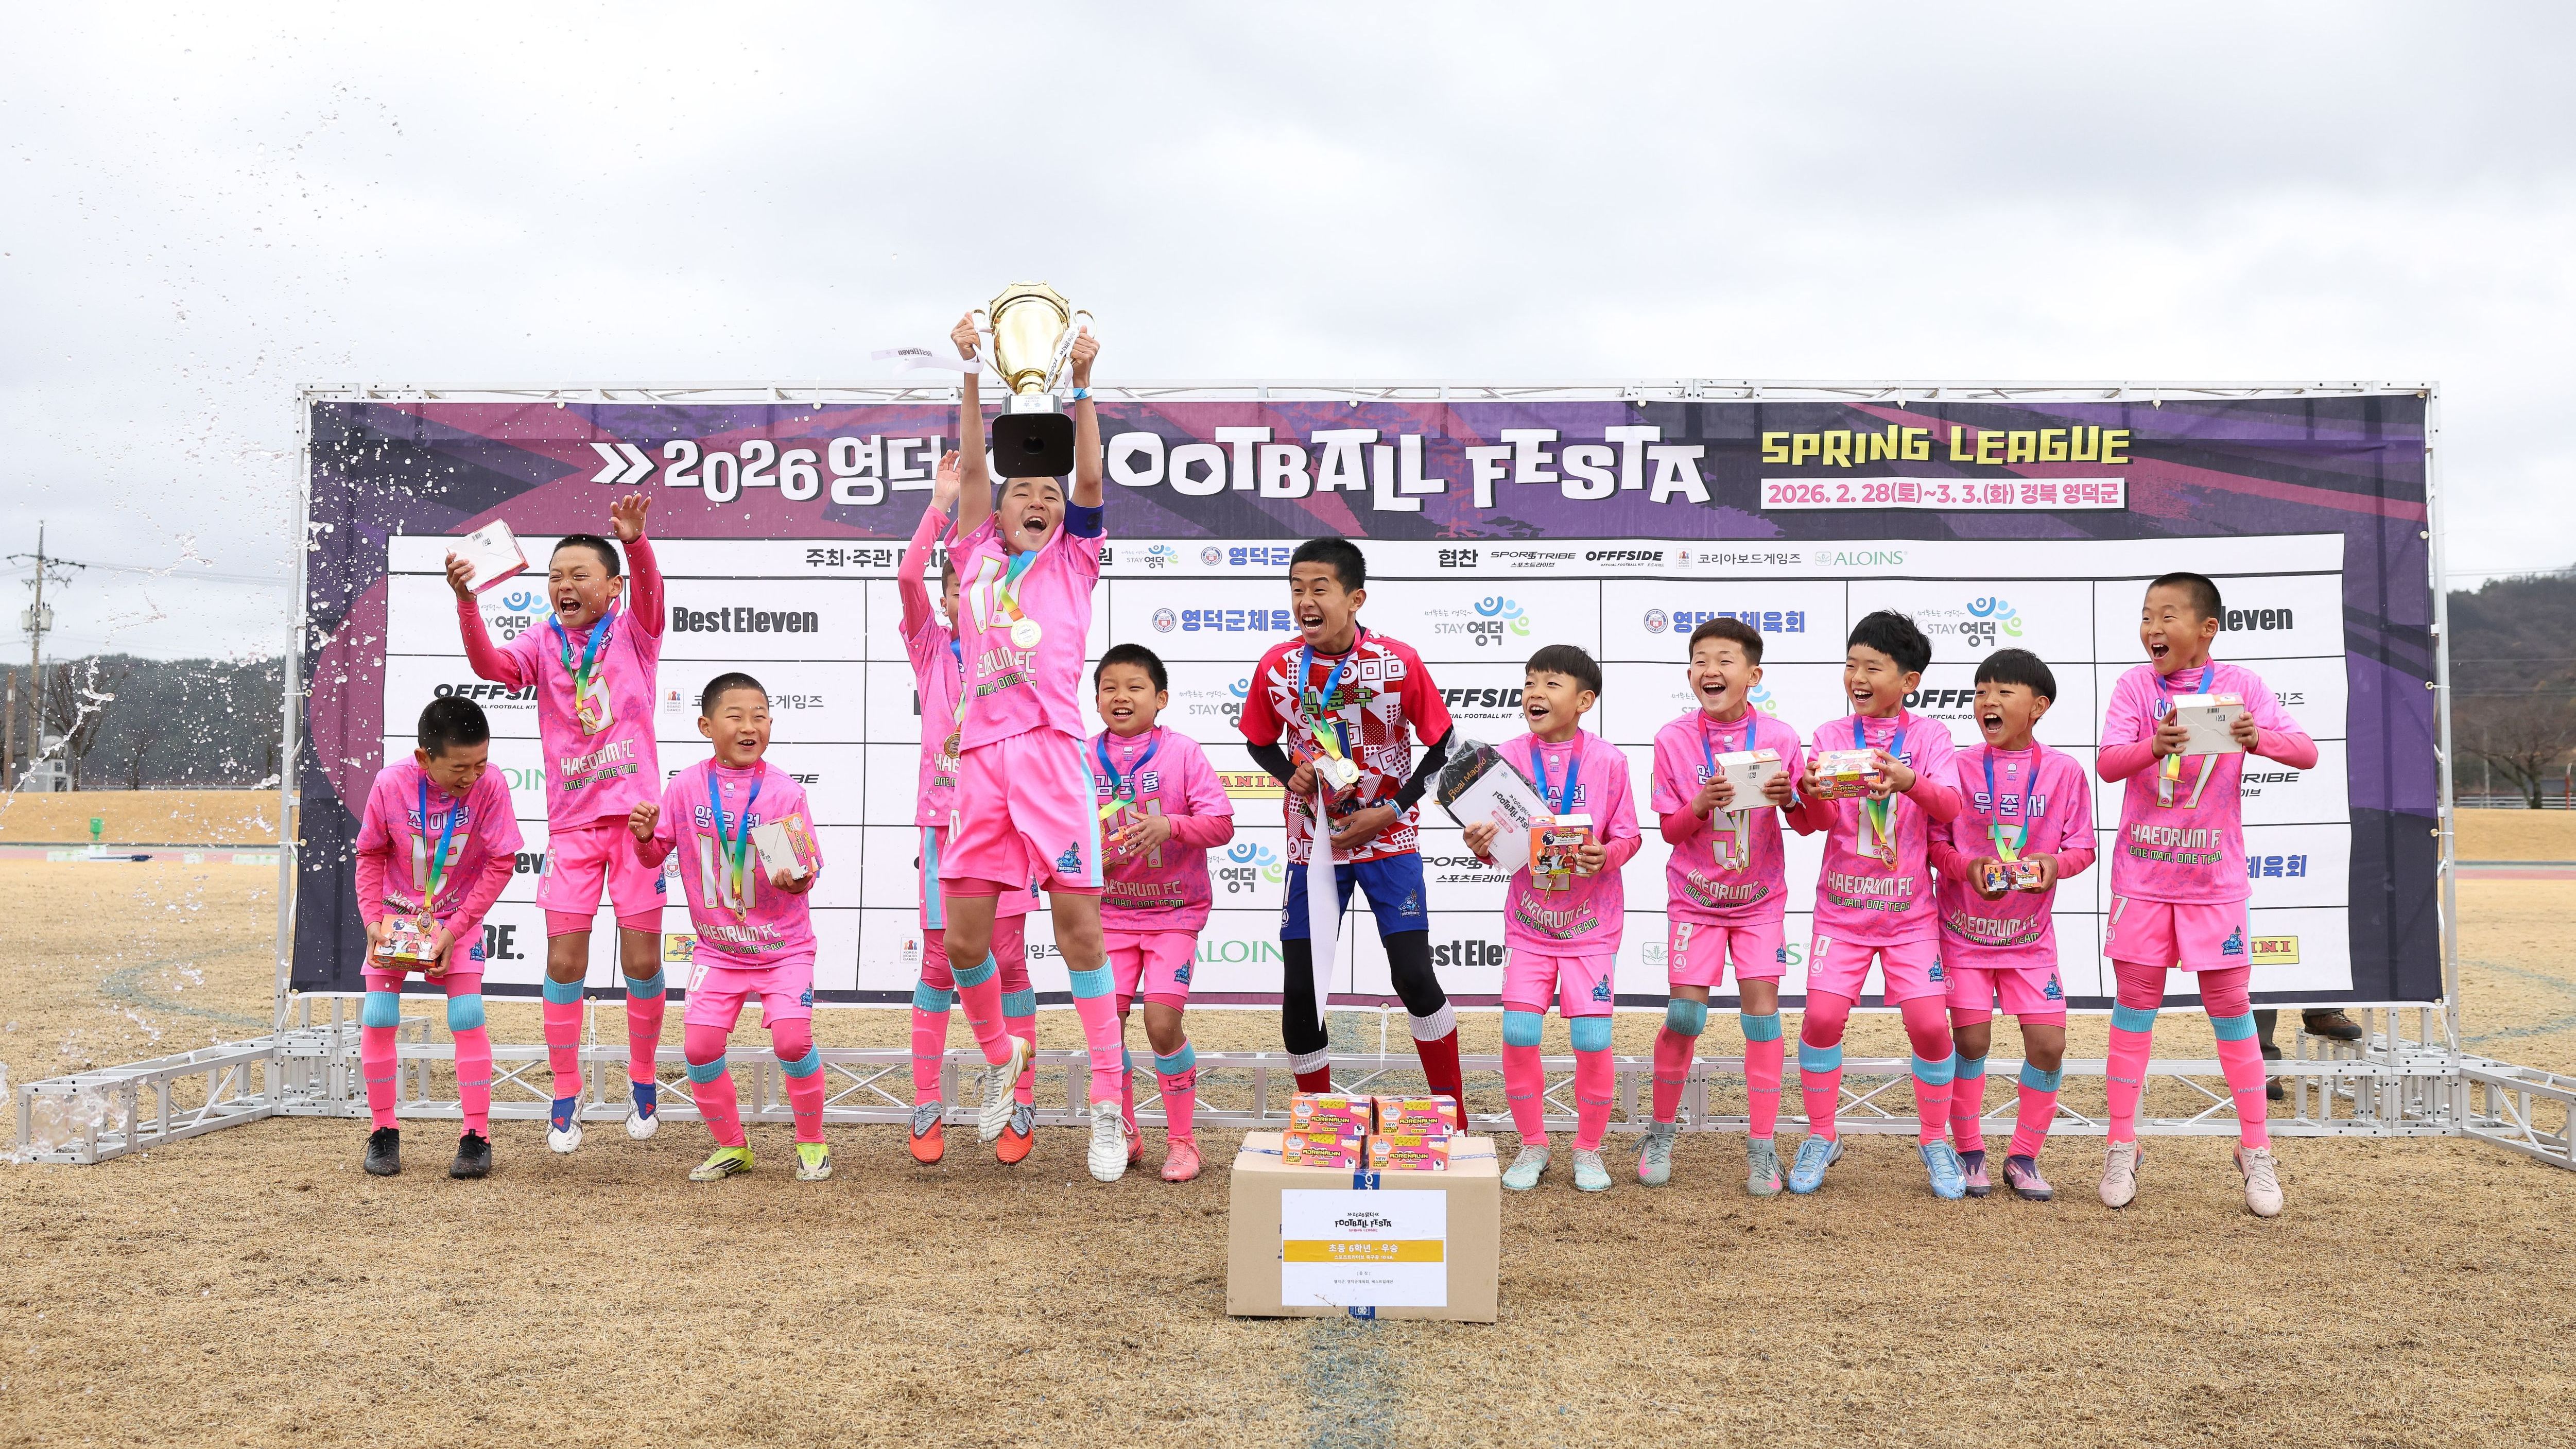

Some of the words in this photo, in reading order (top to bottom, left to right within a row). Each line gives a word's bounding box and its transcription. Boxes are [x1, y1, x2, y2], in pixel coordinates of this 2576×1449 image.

[1762, 424, 1930, 468] SPRING
[1950, 425, 2130, 465] LEAGUE
[664, 440, 820, 503] 2026
[828, 434, 941, 506] 영덕
[1068, 426, 1445, 512] OOTBALL
[1465, 425, 1711, 508] FESTA
[1768, 485, 1830, 504] 2026.
[1836, 485, 1856, 504] 2.
[2020, 484, 2058, 505] 경북
[2062, 482, 2119, 504] 영덕군
[806, 548, 893, 567] 주최·주관
[1144, 556, 1165, 569] 영덕
[1229, 547, 1296, 566] 영덕군
[1438, 549, 1479, 568] 협찬
[1585, 550, 1663, 561] OFFFSIDE
[1698, 553, 1802, 565] 코리아보드게임즈
[1833, 551, 1904, 566] ALOINS
[673, 607, 818, 633] BestEleven
[1182, 610, 1301, 631] 영덕군체육
[1434, 623, 1465, 634] STAY
[1466, 621, 1504, 647] 영덕
[1927, 623, 1958, 634] STAY
[1959, 621, 1996, 647] 영덕
[1014, 650, 1038, 674] FC
[997, 673, 1016, 689] ONE
[1189, 704, 1220, 715] STAY
[1303, 688, 1373, 714] 김윤구
[620, 738, 636, 760] FC
[564, 780, 582, 792] ONE
[597, 767, 618, 780] ONE
[934, 776, 950, 787] ONE
[1094, 770, 1160, 797] 김도율
[1219, 775, 1285, 788] ANIN
[1447, 781, 1465, 799] Real
[1463, 756, 1488, 783] Madrid
[1492, 790, 1518, 818] FOOTBALL
[1973, 791, 2046, 817] 우준서
[1712, 809, 1751, 871] 9
[2130, 822, 2208, 849] HAEORUM
[2130, 844, 2148, 859] ONE
[2150, 849, 2174, 864] MAN,
[2176, 852, 2199, 865] ONE
[2201, 850, 2223, 865] TEAM
[697, 833, 756, 910] 18
[1219, 867, 1256, 894] 영덕
[1163, 880, 1182, 895] FC
[1683, 884, 1702, 898] ONE
[1686, 868, 1753, 901] HAEORUM
[1827, 870, 1895, 896] HAEORUM
[1897, 876, 1915, 898] FC
[1137, 899, 1156, 908] ONE
[1157, 899, 1184, 908] TEAM
[1576, 899, 1592, 920] FC
[1828, 893, 1842, 906] ONE
[1866, 900, 1885, 911] ONE
[1886, 900, 1911, 912] TEAM
[762, 922, 782, 938] FC
[1515, 910, 1532, 926] ONE
[1570, 918, 1599, 936] TEAM
[1946, 920, 1963, 936] ONE
[2014, 932, 2040, 945] TEAM
[1950, 906, 2021, 938] HAEORUM
[2021, 912, 2038, 928] FC
[1673, 922, 1694, 952] 9
[739, 944, 762, 954] ONE
[1335, 1219, 1369, 1228] FOOTBALL
[1370, 1219, 1392, 1228] FESTA
[1328, 1244, 1346, 1253] 초등
[1348, 1244, 1371, 1253] 6학년
[1381, 1244, 1398, 1253] 우승
